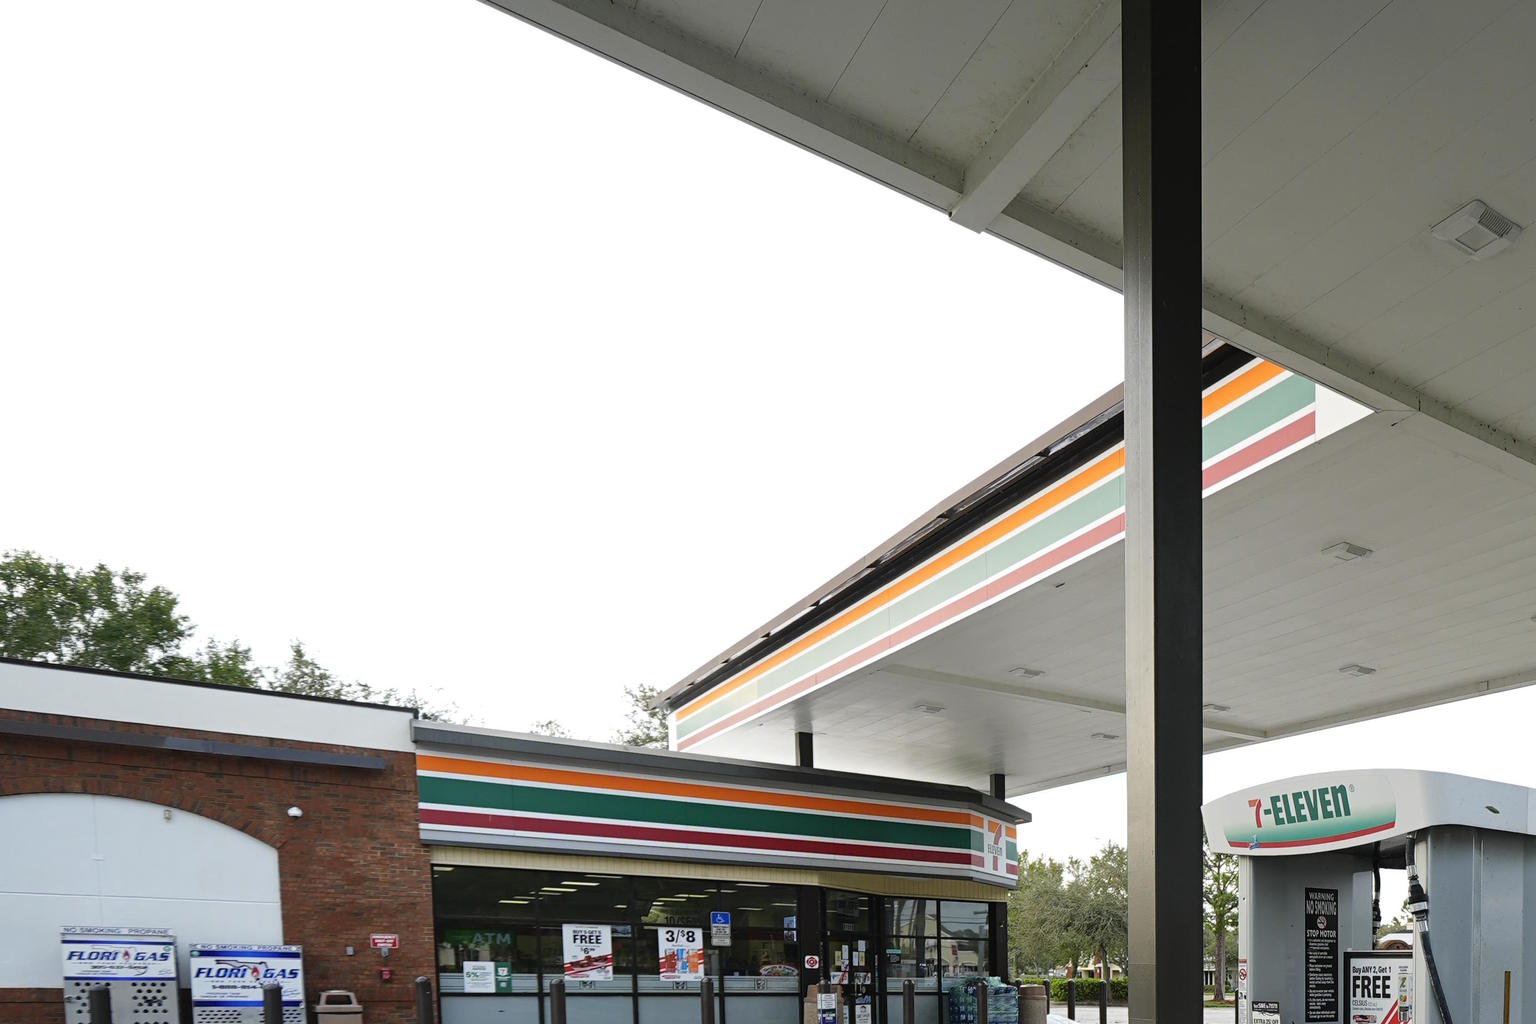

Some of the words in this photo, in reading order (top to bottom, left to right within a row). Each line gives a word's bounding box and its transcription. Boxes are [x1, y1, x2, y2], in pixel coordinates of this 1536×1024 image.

[1309, 892, 1334, 901] WARNING
[1306, 900, 1314, 915] NO
[1315, 901, 1336, 915] SMOKING
[1307, 929, 1319, 937] STOP
[1320, 930, 1336, 938] MOTOR
[472, 933, 511, 945] ATM
[573, 934, 602, 944] FREE
[134, 952, 171, 961] GAS
[194, 968, 248, 978] FLORI
[263, 968, 300, 979] GAS
[1352, 975, 1391, 998] FREE
